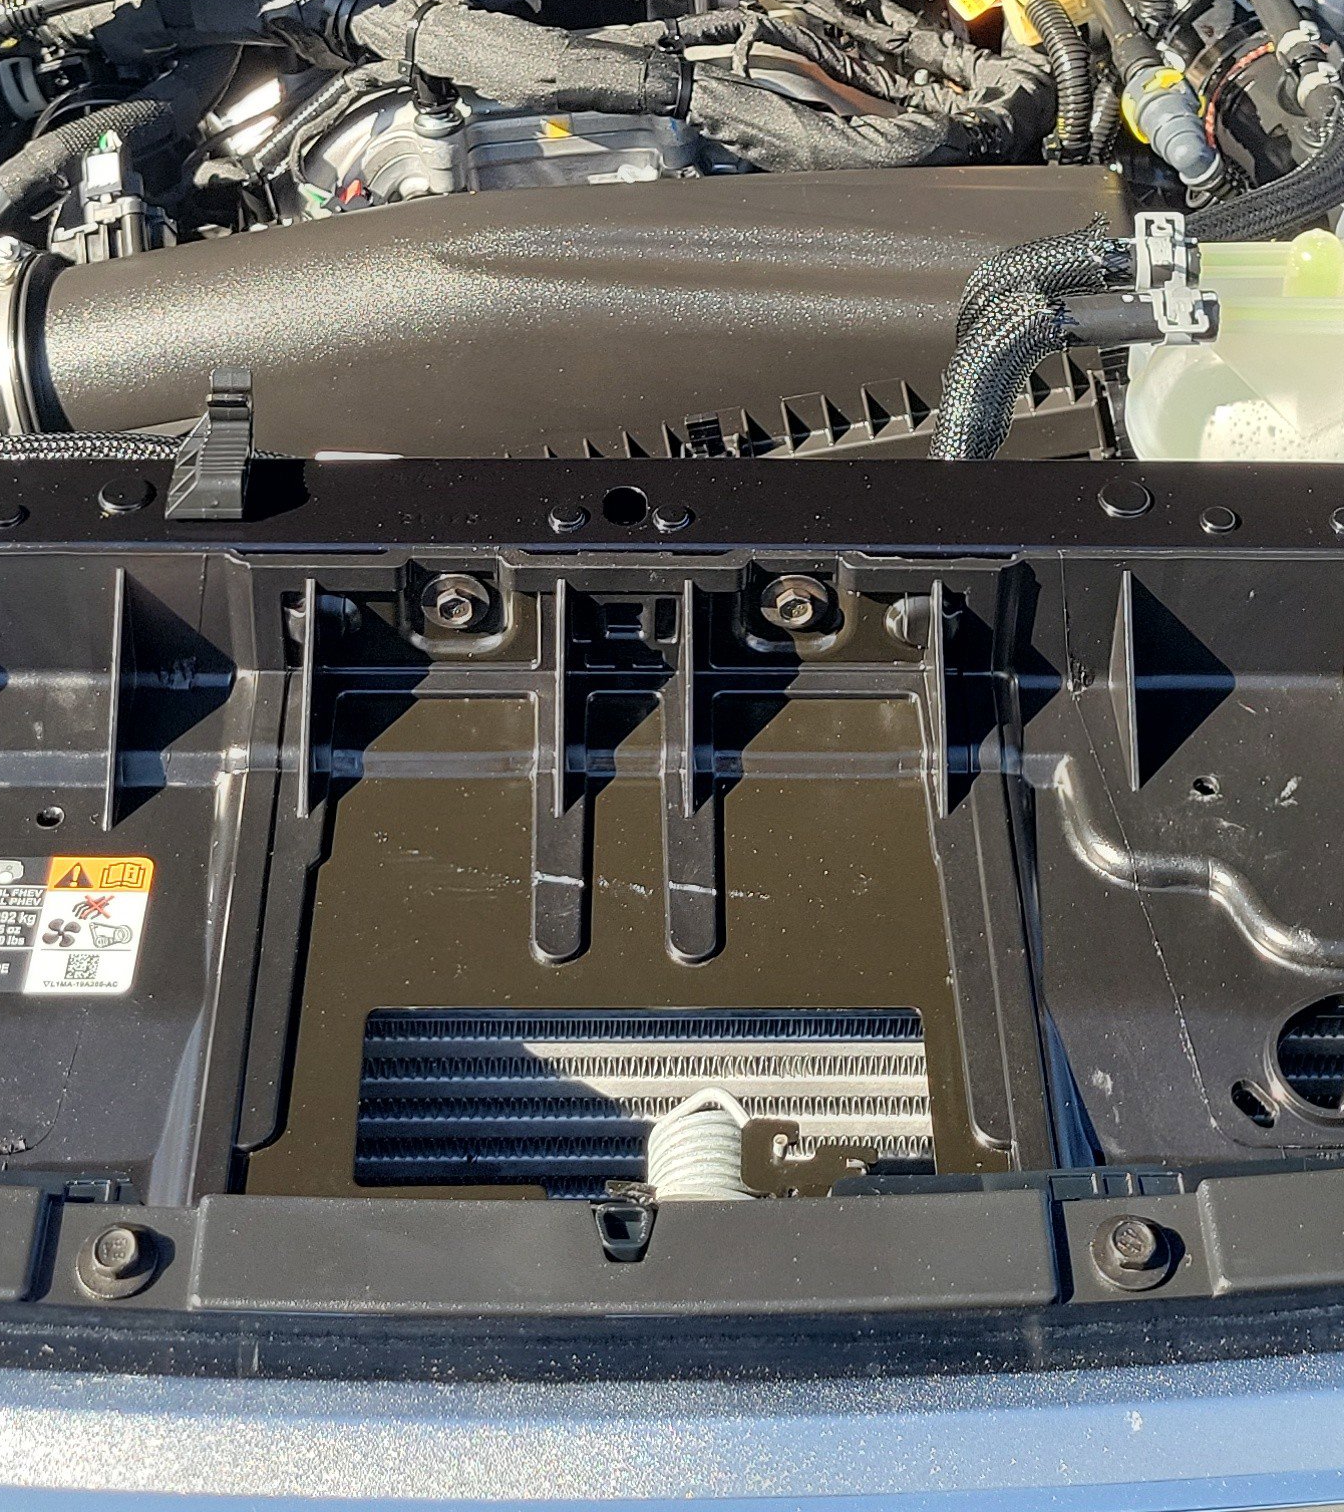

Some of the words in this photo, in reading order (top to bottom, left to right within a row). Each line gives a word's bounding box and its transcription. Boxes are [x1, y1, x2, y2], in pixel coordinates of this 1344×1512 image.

[18, 912, 36, 927] kg
[6, 926, 21, 935] oz
[7, 935, 25, 945] lbs
